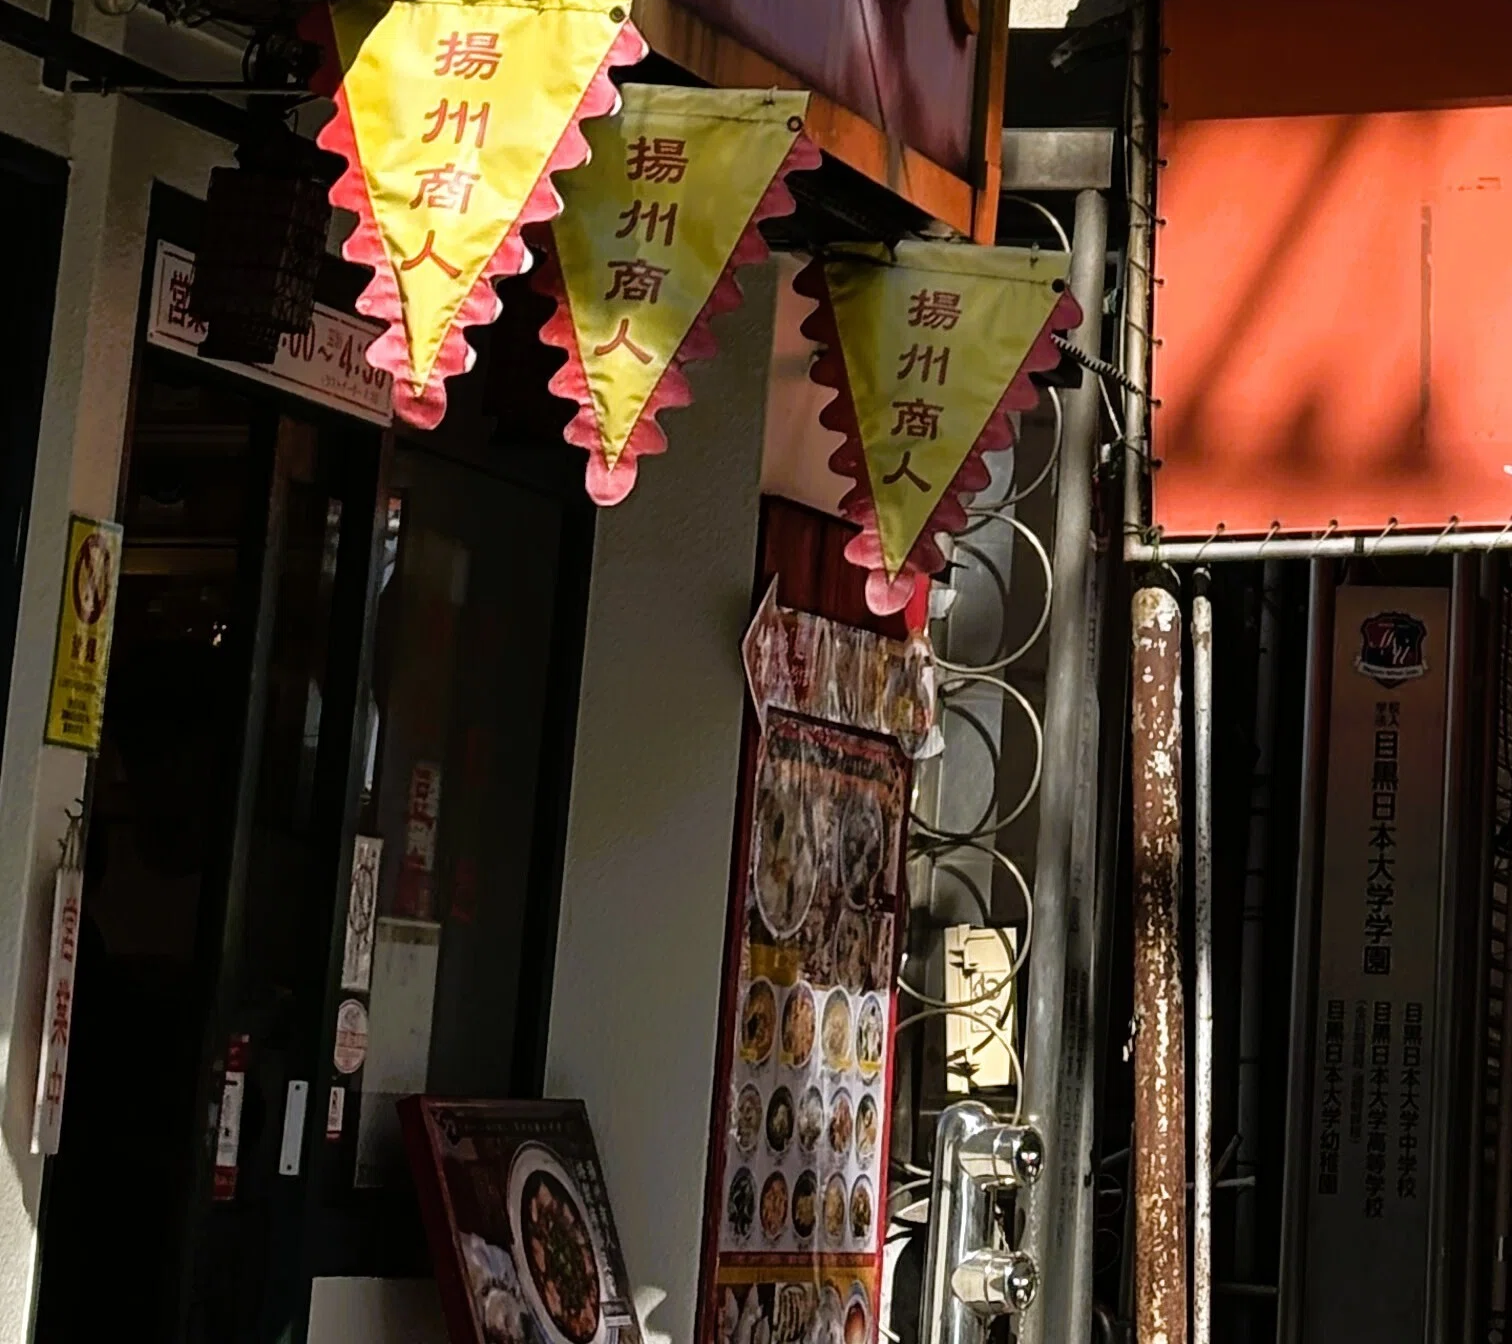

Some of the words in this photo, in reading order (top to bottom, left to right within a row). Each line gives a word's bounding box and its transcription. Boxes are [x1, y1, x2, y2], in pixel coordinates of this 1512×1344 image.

[400, 30, 503, 280] 揚州商人
[594, 134, 690, 366] 揚州商人
[882, 288, 962, 493] 揚州商人
